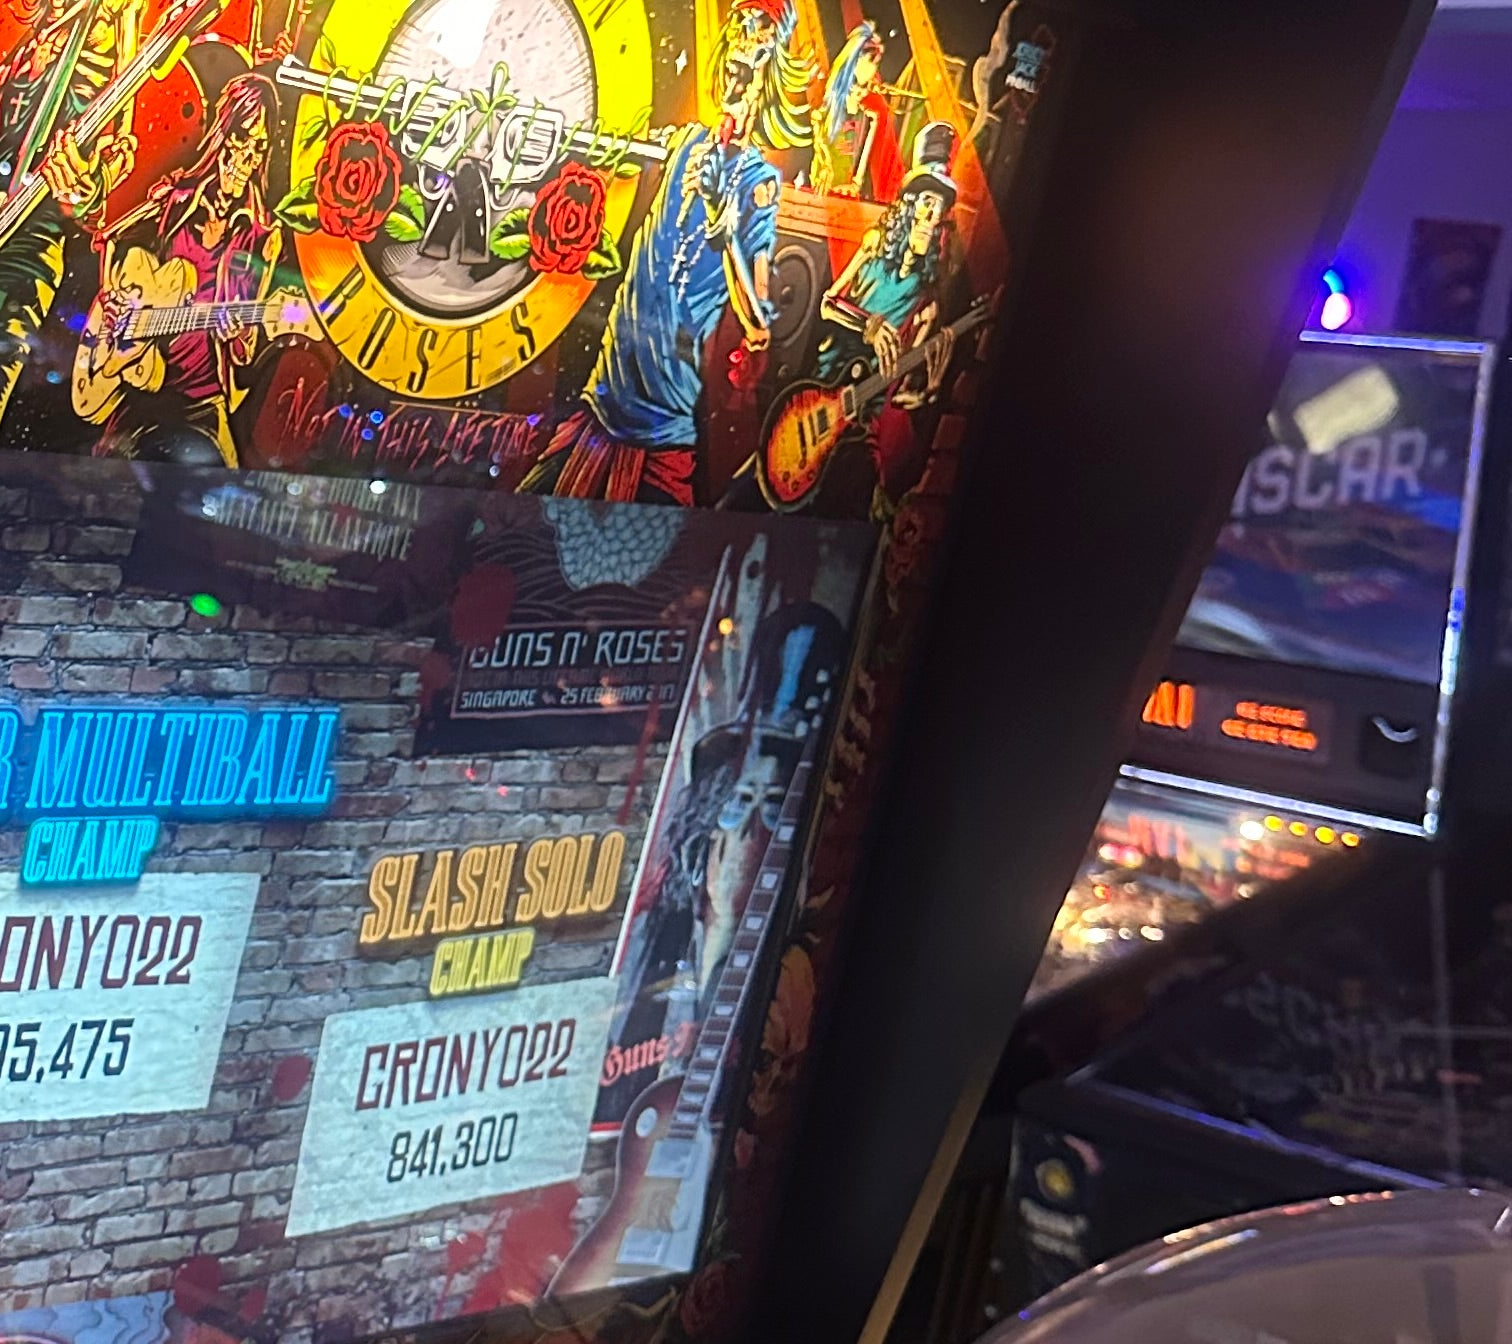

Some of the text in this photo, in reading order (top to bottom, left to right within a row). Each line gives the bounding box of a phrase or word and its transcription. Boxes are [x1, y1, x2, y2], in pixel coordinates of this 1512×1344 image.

[319, 267, 536, 394] ROSES
[593, 629, 686, 667] ROSES
[459, 689, 537, 709] SINGAPORE
[560, 687, 578, 704] 25
[25, 707, 340, 811] MULTIBALL
[21, 817, 160, 886] CHAMP
[360, 830, 627, 946] SLASH SOLO
[430, 928, 534, 998] CHAMP
[387, 1112, 519, 1185] 841,300
